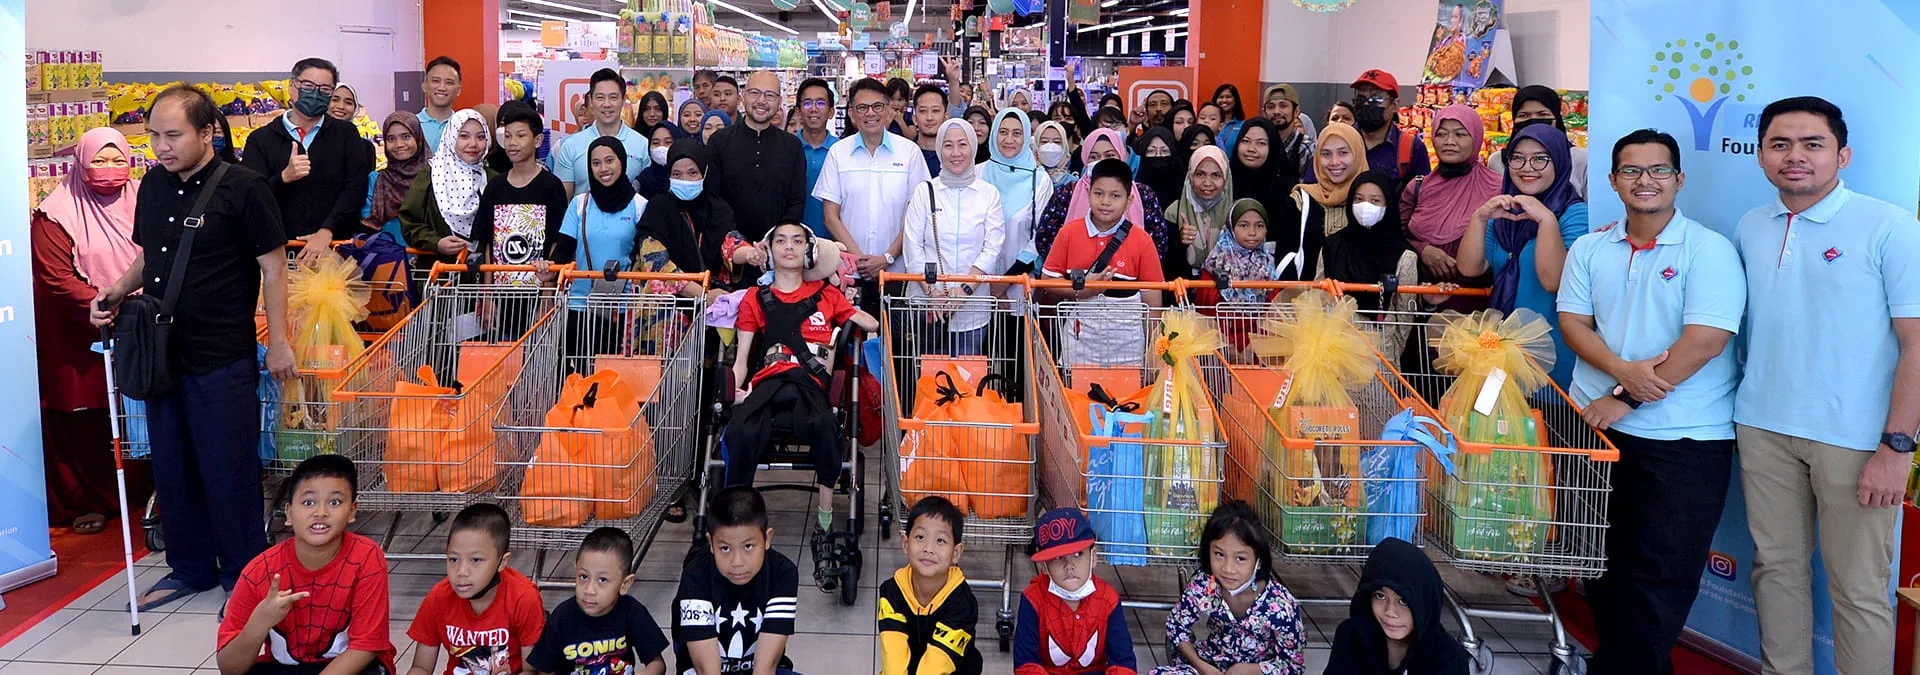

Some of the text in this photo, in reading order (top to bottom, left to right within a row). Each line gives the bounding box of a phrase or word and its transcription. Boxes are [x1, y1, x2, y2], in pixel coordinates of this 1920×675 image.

[1721, 137, 1760, 155] Fou
[1165, 383, 1173, 408] BIG
[1039, 517, 1077, 545] BOY
[446, 625, 510, 647] WANTED
[563, 635, 627, 660] SONIC
